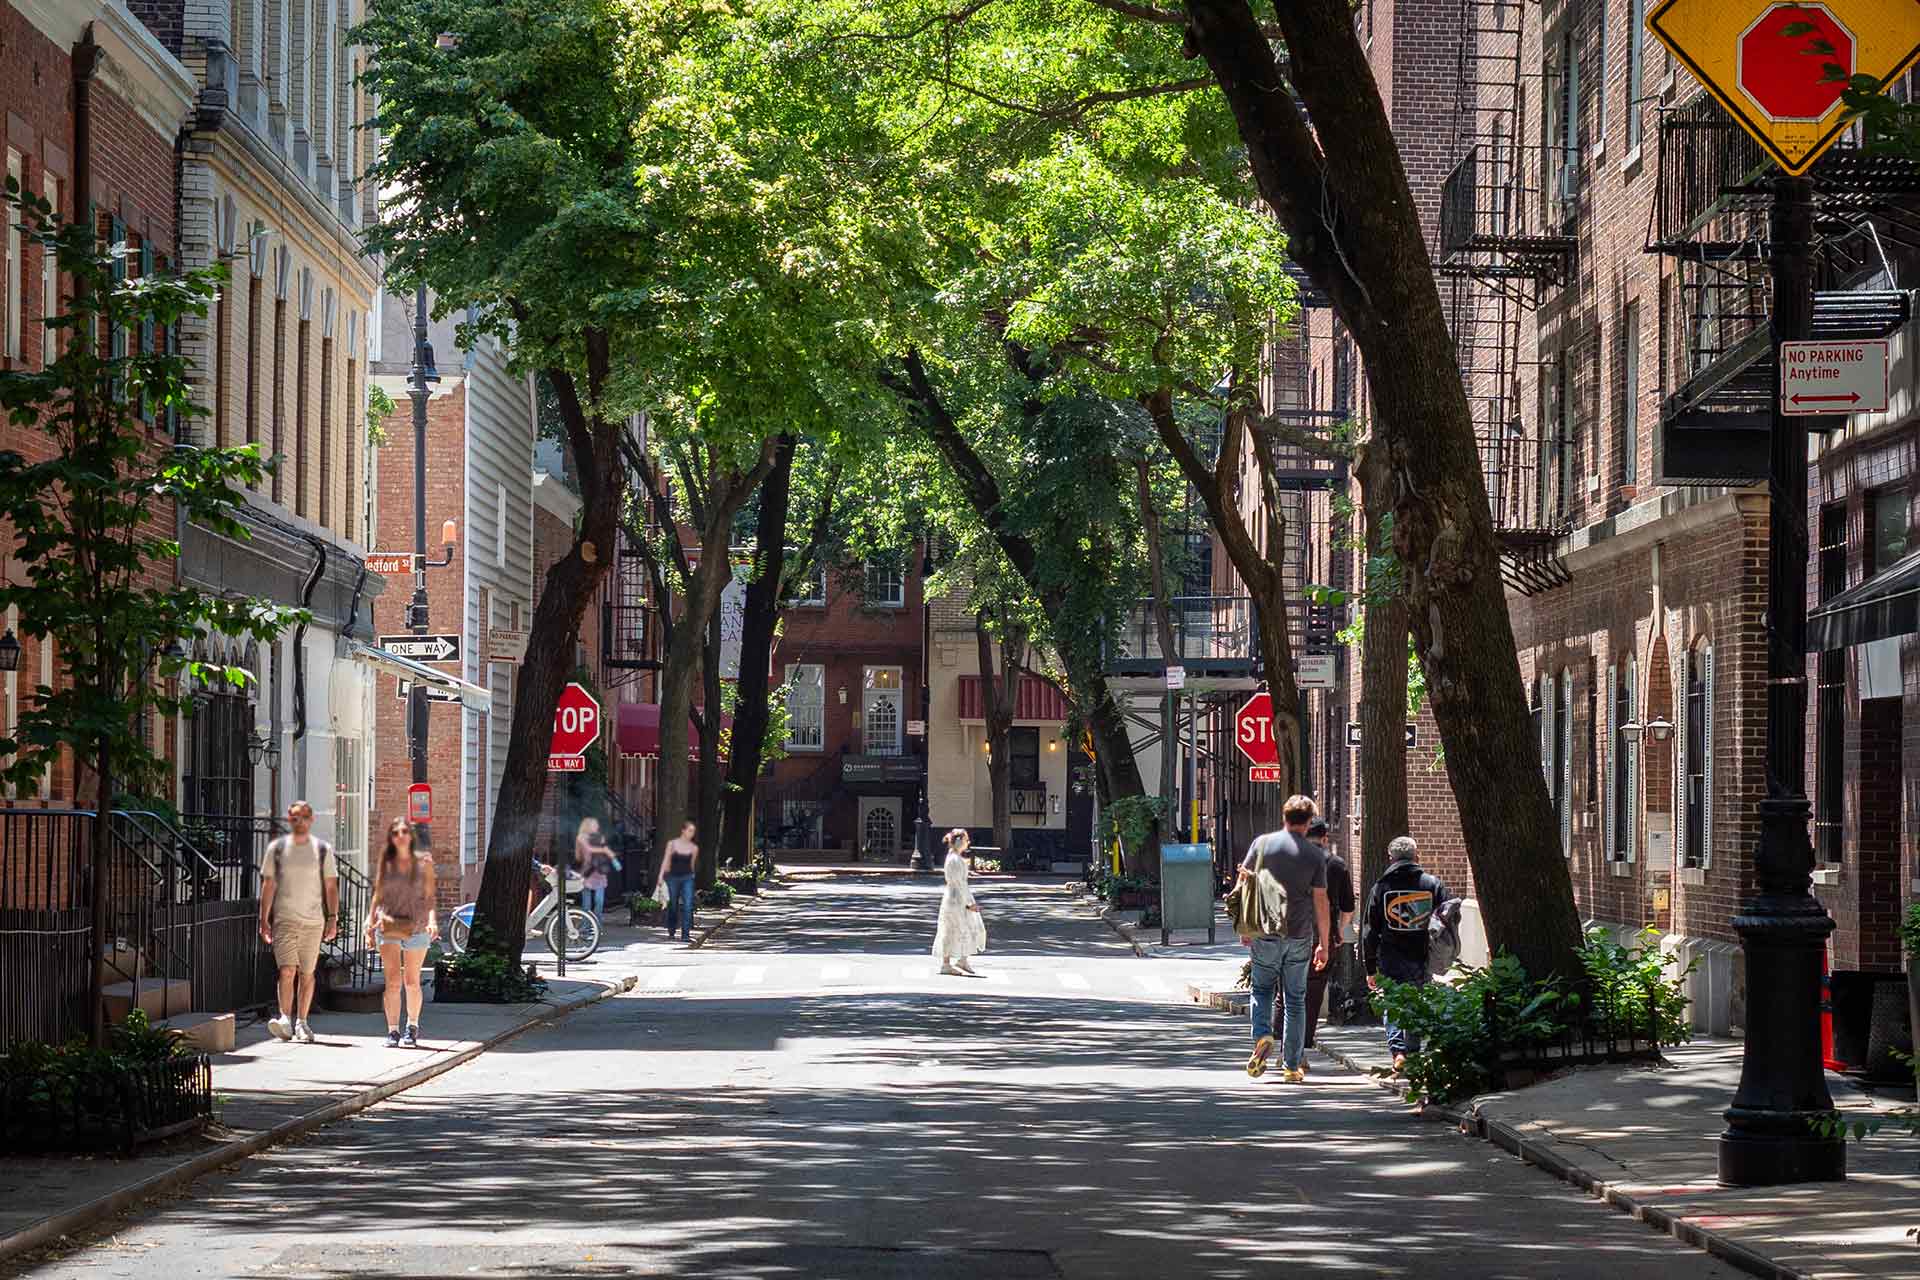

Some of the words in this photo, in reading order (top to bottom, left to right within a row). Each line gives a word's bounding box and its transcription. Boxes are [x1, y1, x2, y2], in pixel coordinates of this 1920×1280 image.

[1789, 350, 1806, 363] NO
[1810, 349, 1864, 362] PARKING
[1790, 366, 1840, 381] Anytime
[391, 644, 414, 654] ONE
[424, 643, 448, 654] WAY
[553, 707, 594, 733] OP
[1241, 716, 1276, 743] ST
[563, 760, 580, 769] WAY
[1254, 769, 1270, 779] ALL
